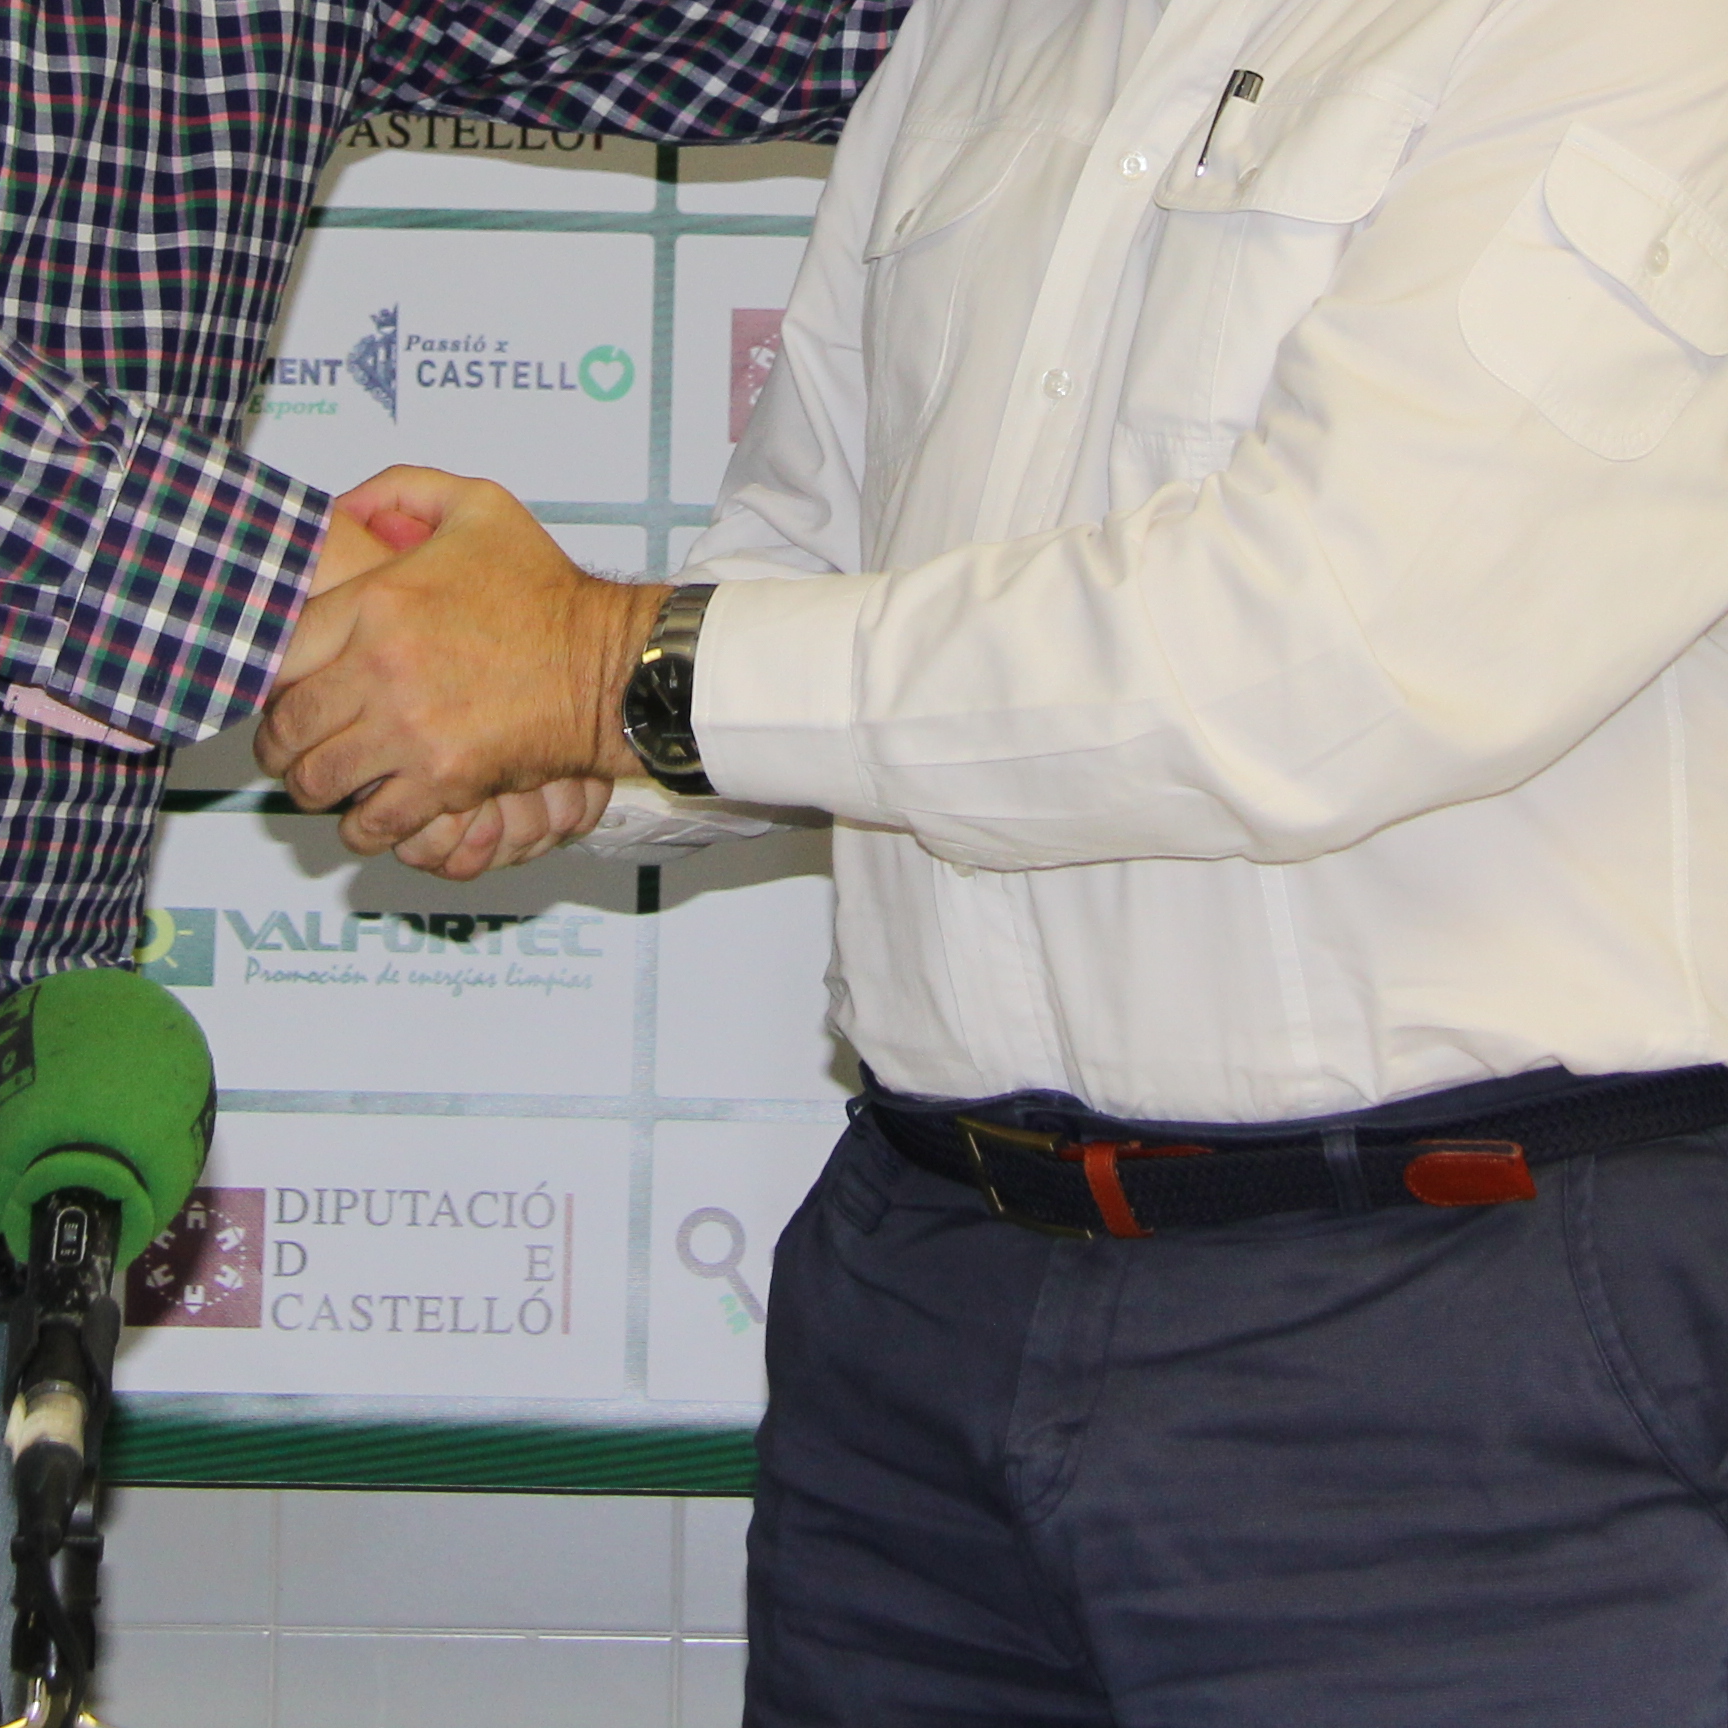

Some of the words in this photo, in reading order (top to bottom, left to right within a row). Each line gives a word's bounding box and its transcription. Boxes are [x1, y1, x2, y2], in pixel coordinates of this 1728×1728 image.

[404, 334, 486, 352] Passió
[224, 909, 603, 957] VALFORTEC
[274, 1181, 558, 1230] DIPUTACIÓ
[272, 1284, 555, 1336] CASTELLÓ
